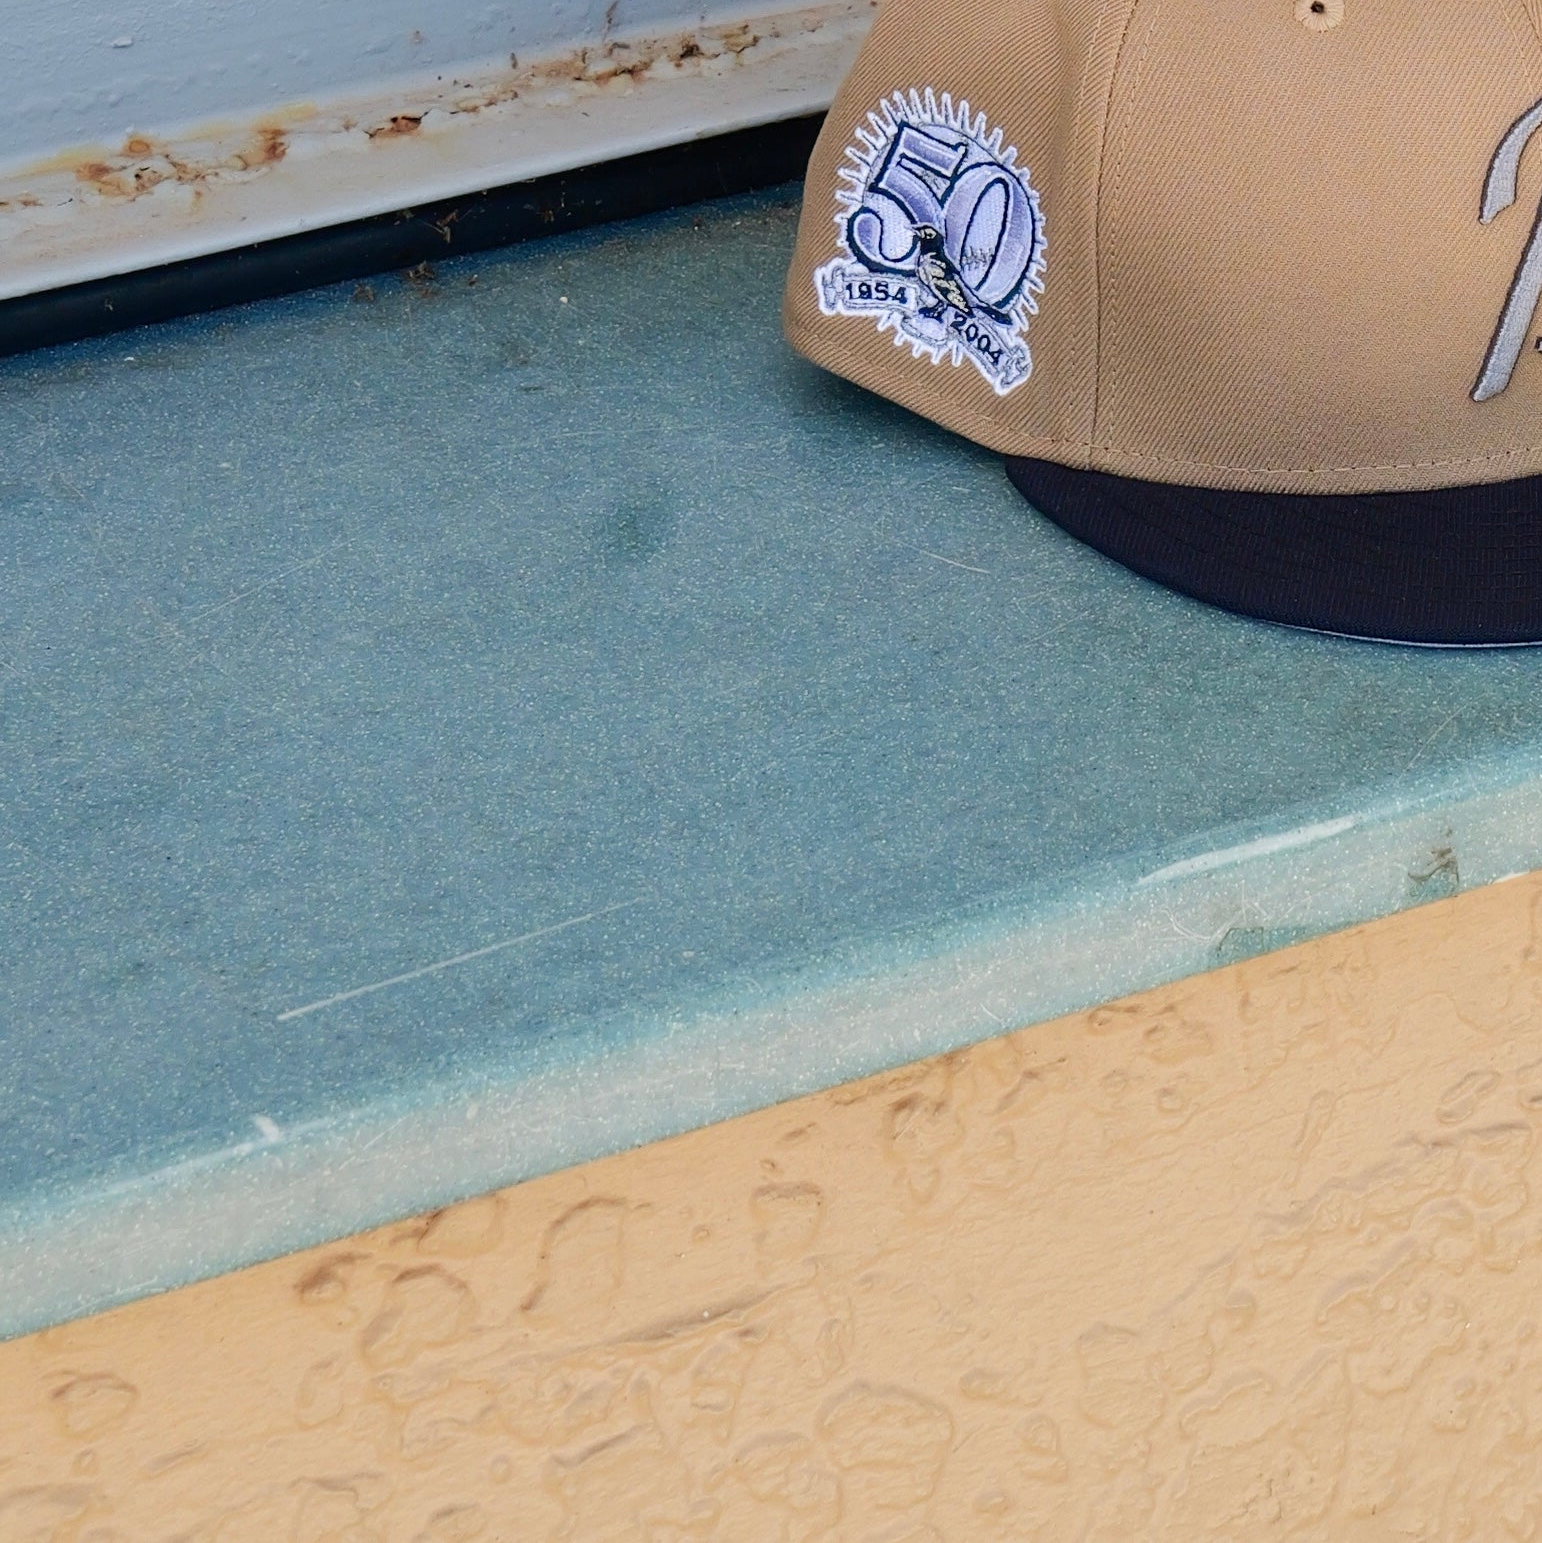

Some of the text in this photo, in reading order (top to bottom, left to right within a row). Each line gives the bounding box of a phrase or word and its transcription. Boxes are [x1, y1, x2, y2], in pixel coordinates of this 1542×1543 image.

[847, 120, 1036, 309] 50
[845, 280, 1003, 366] 1954 2004
